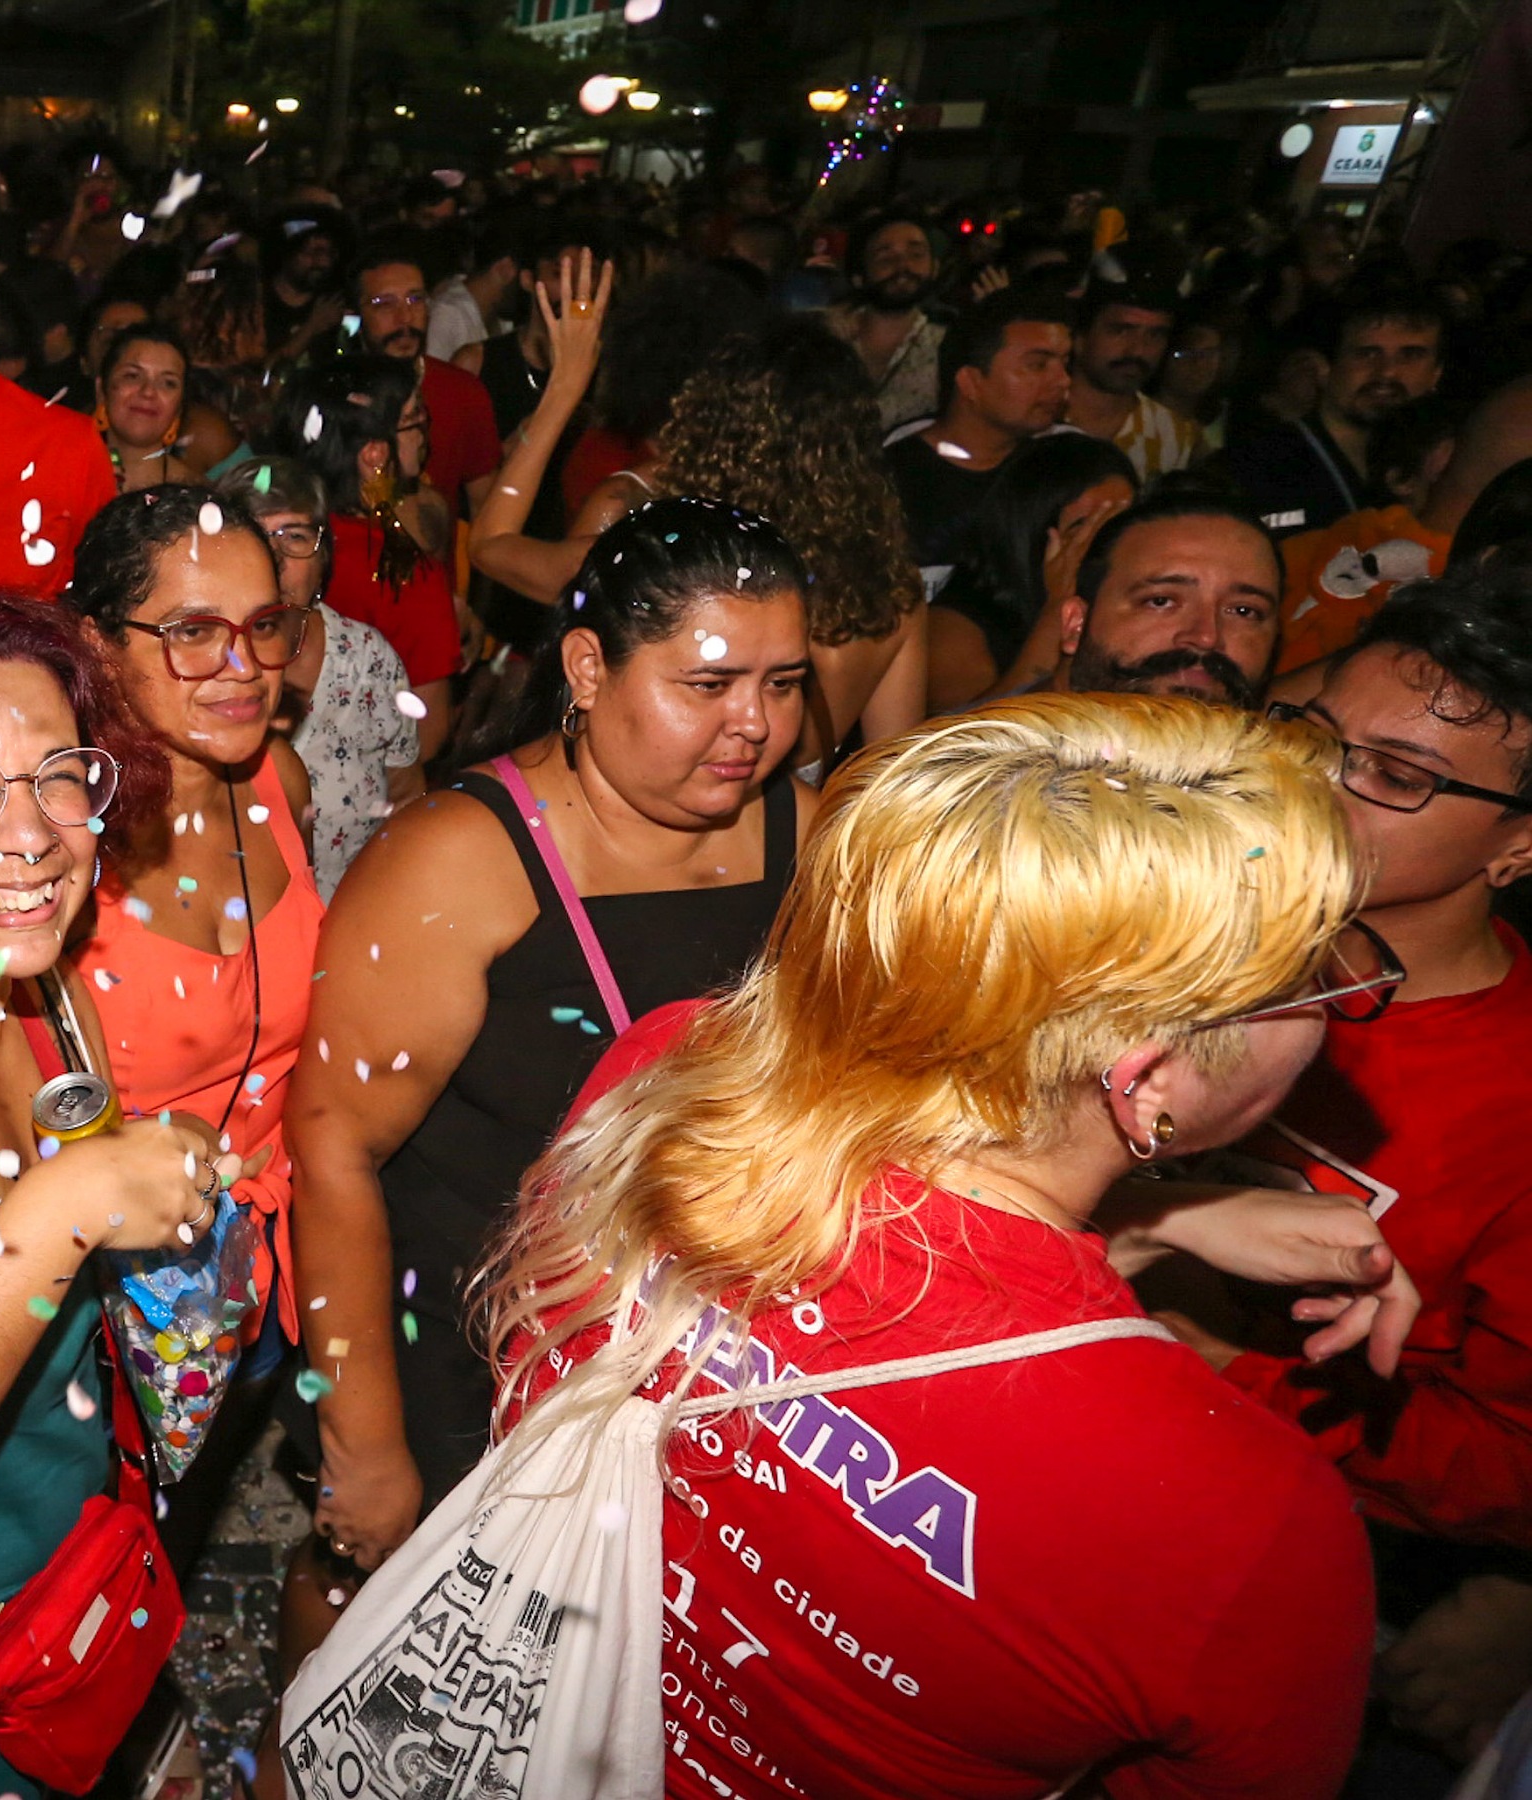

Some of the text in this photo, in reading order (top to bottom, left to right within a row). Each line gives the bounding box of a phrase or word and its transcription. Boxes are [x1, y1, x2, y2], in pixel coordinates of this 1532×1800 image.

[1334, 154, 1384, 170] CEARÁ
[636, 1256, 977, 1600] ENTRA
[734, 1450, 787, 1494] SAI
[719, 1524, 762, 1574] da
[774, 1578, 920, 1697] cidade
